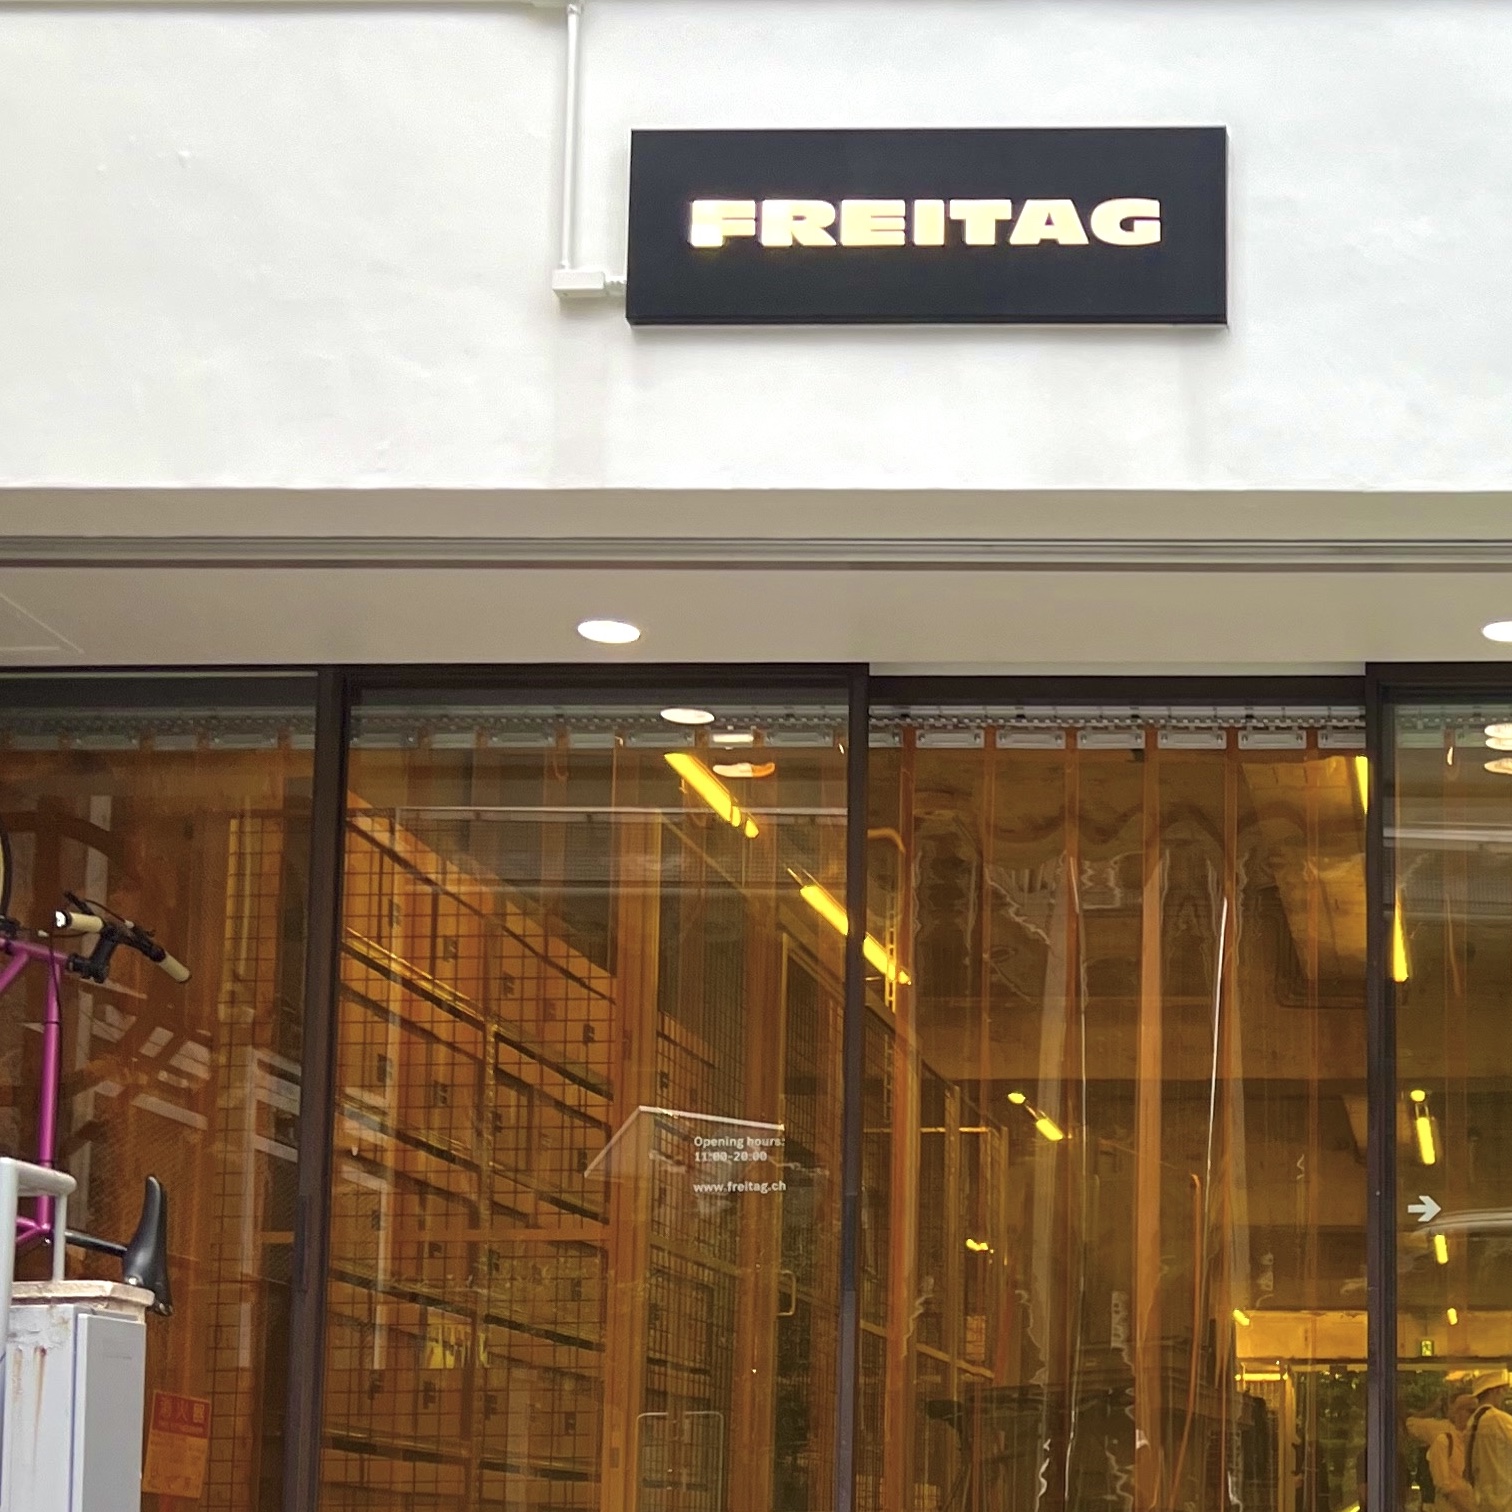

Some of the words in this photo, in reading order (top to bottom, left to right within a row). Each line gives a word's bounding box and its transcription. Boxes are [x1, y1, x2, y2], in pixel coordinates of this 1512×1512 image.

[689, 198, 1161, 247] FREITAG
[693, 1136, 744, 1149] Opening
[747, 1136, 785, 1147] hours:
[695, 1151, 767, 1161] 11:00-20:00
[693, 1180, 786, 1194] www.freitag.ch
